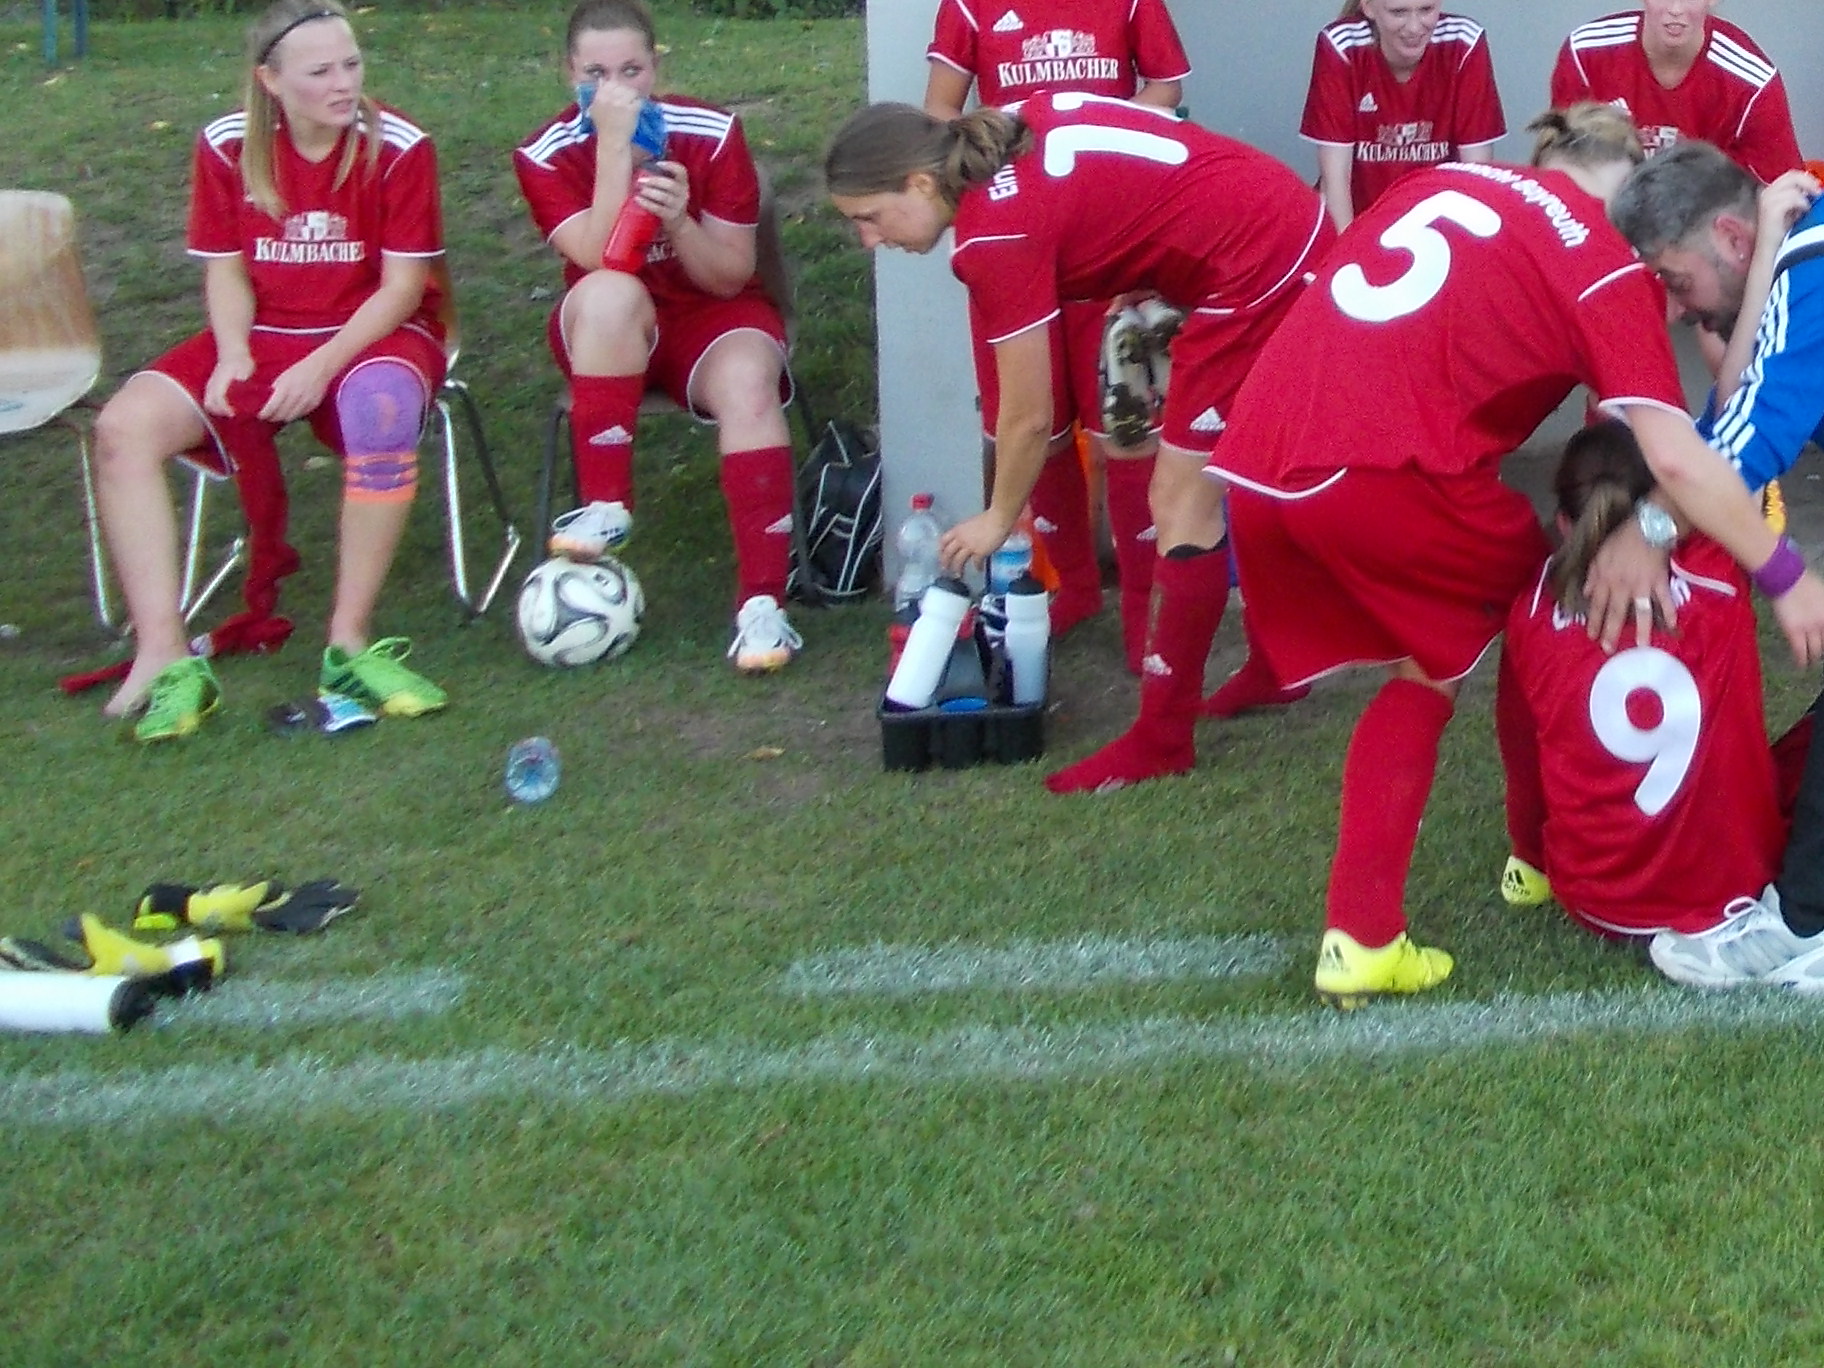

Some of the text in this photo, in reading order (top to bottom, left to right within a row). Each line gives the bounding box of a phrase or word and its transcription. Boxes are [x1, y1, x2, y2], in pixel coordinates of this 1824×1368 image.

[998, 57, 1119, 88] KULMBACHER
[1357, 140, 1449, 161] KULMBACHER
[1330, 189, 1502, 323] 5
[1589, 645, 1702, 817] 9
